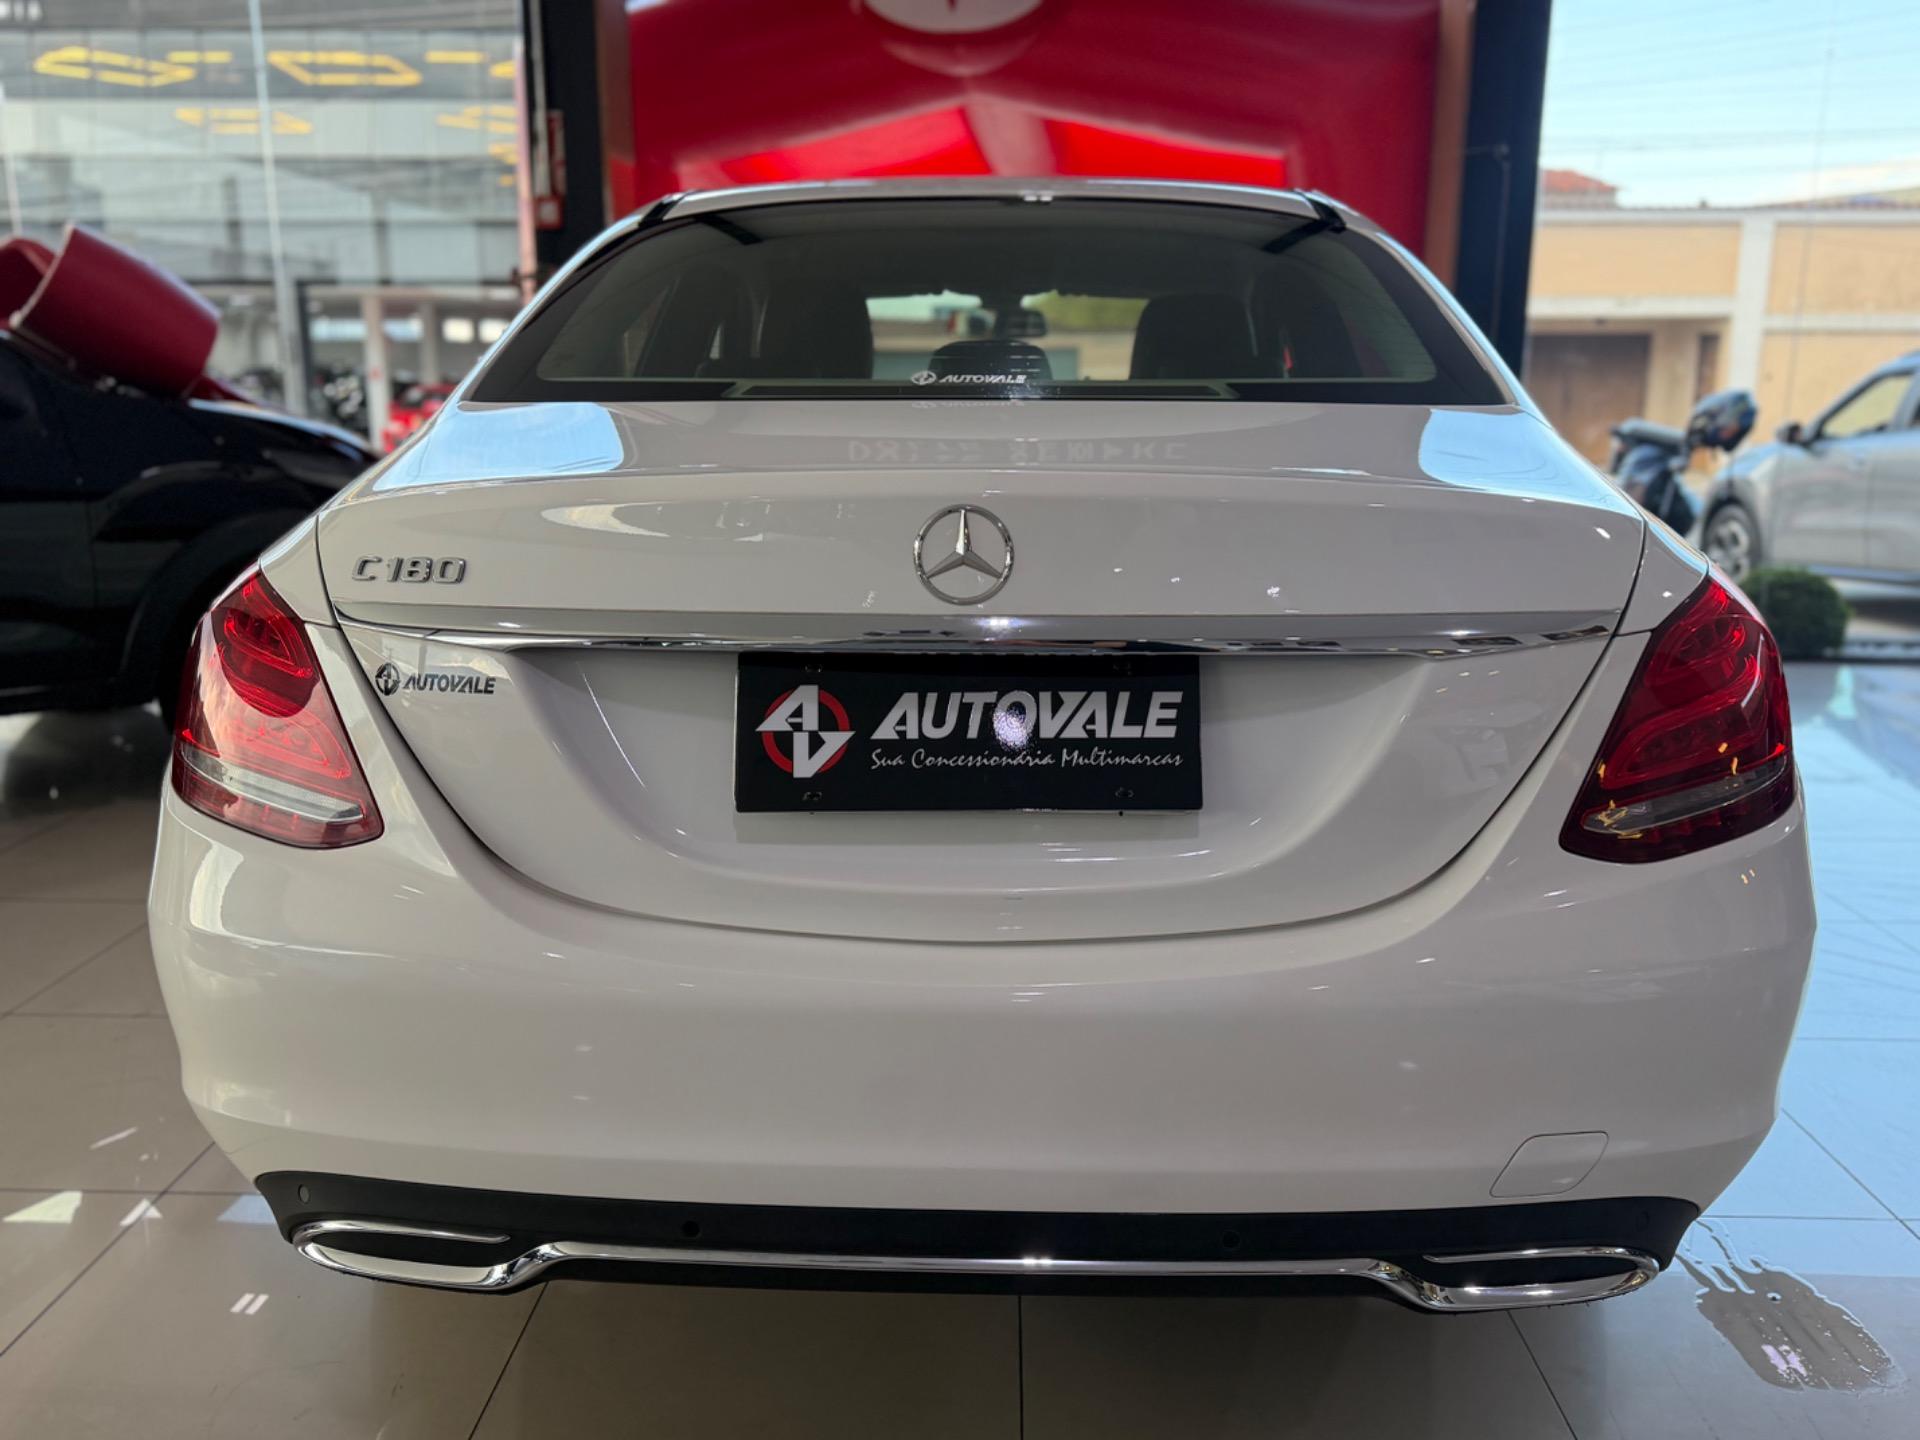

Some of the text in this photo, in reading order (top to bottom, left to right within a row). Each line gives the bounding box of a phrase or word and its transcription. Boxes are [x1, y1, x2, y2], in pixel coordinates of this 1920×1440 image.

[402, 673, 496, 694] AUTOVALE
[870, 690, 1184, 740] AUTOVALE
[871, 748, 905, 769] Sua
[1061, 746, 1184, 768] Multimarcas
